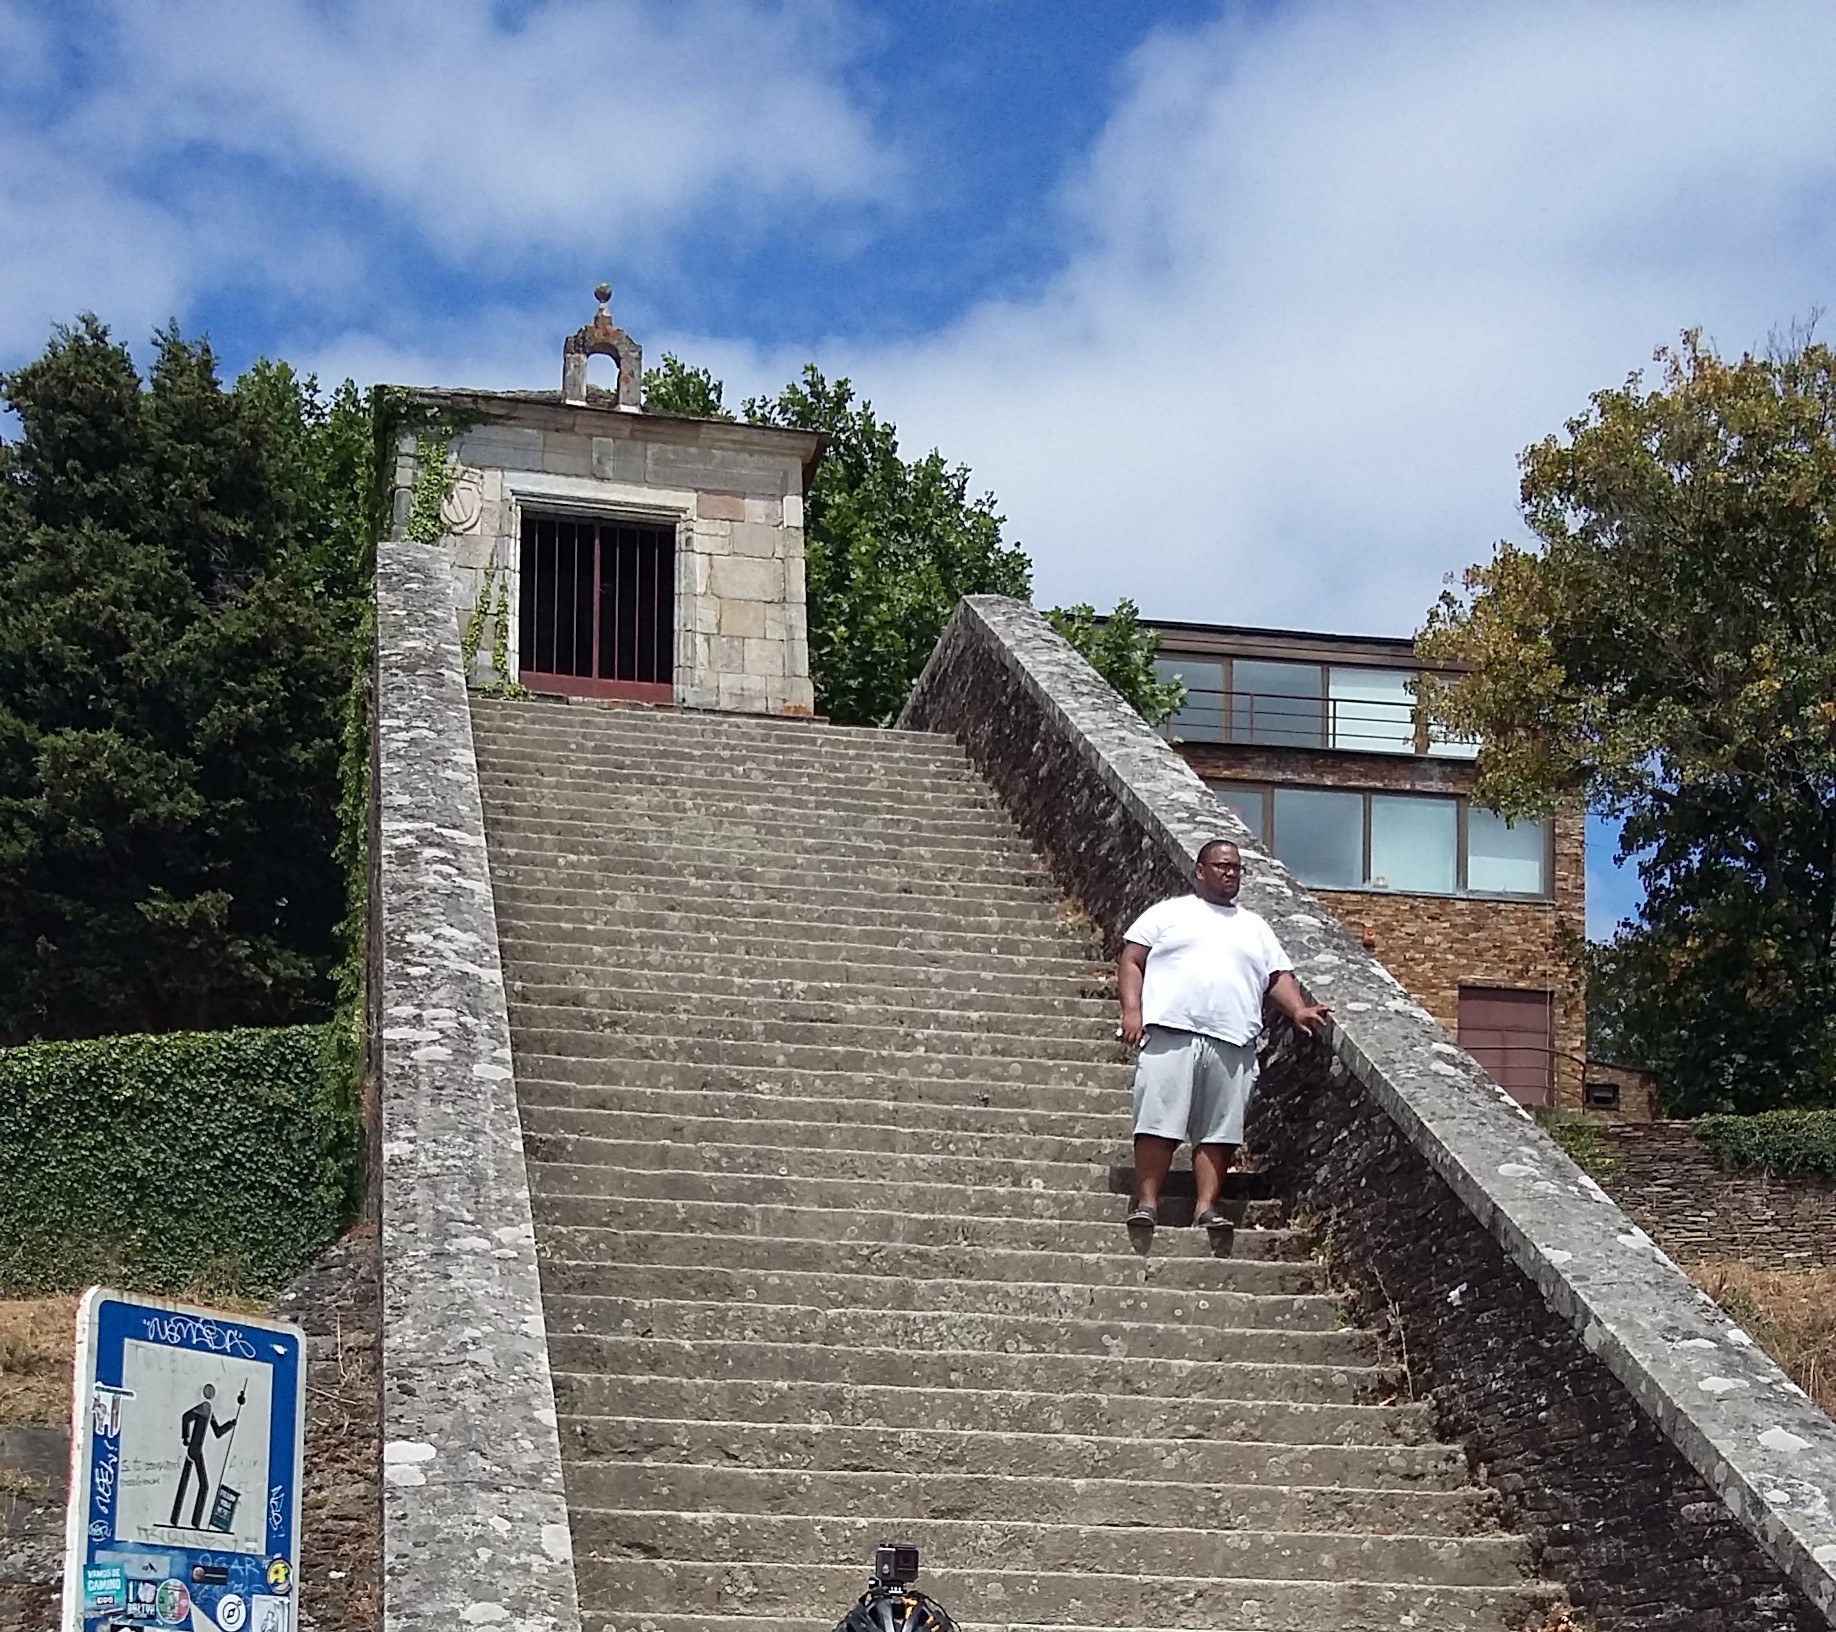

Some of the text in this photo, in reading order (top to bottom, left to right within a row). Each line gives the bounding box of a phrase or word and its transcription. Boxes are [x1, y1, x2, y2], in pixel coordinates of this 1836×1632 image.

[87, 1568, 121, 1578] VAMOS DE
[87, 1579, 121, 1591] CAMINO
